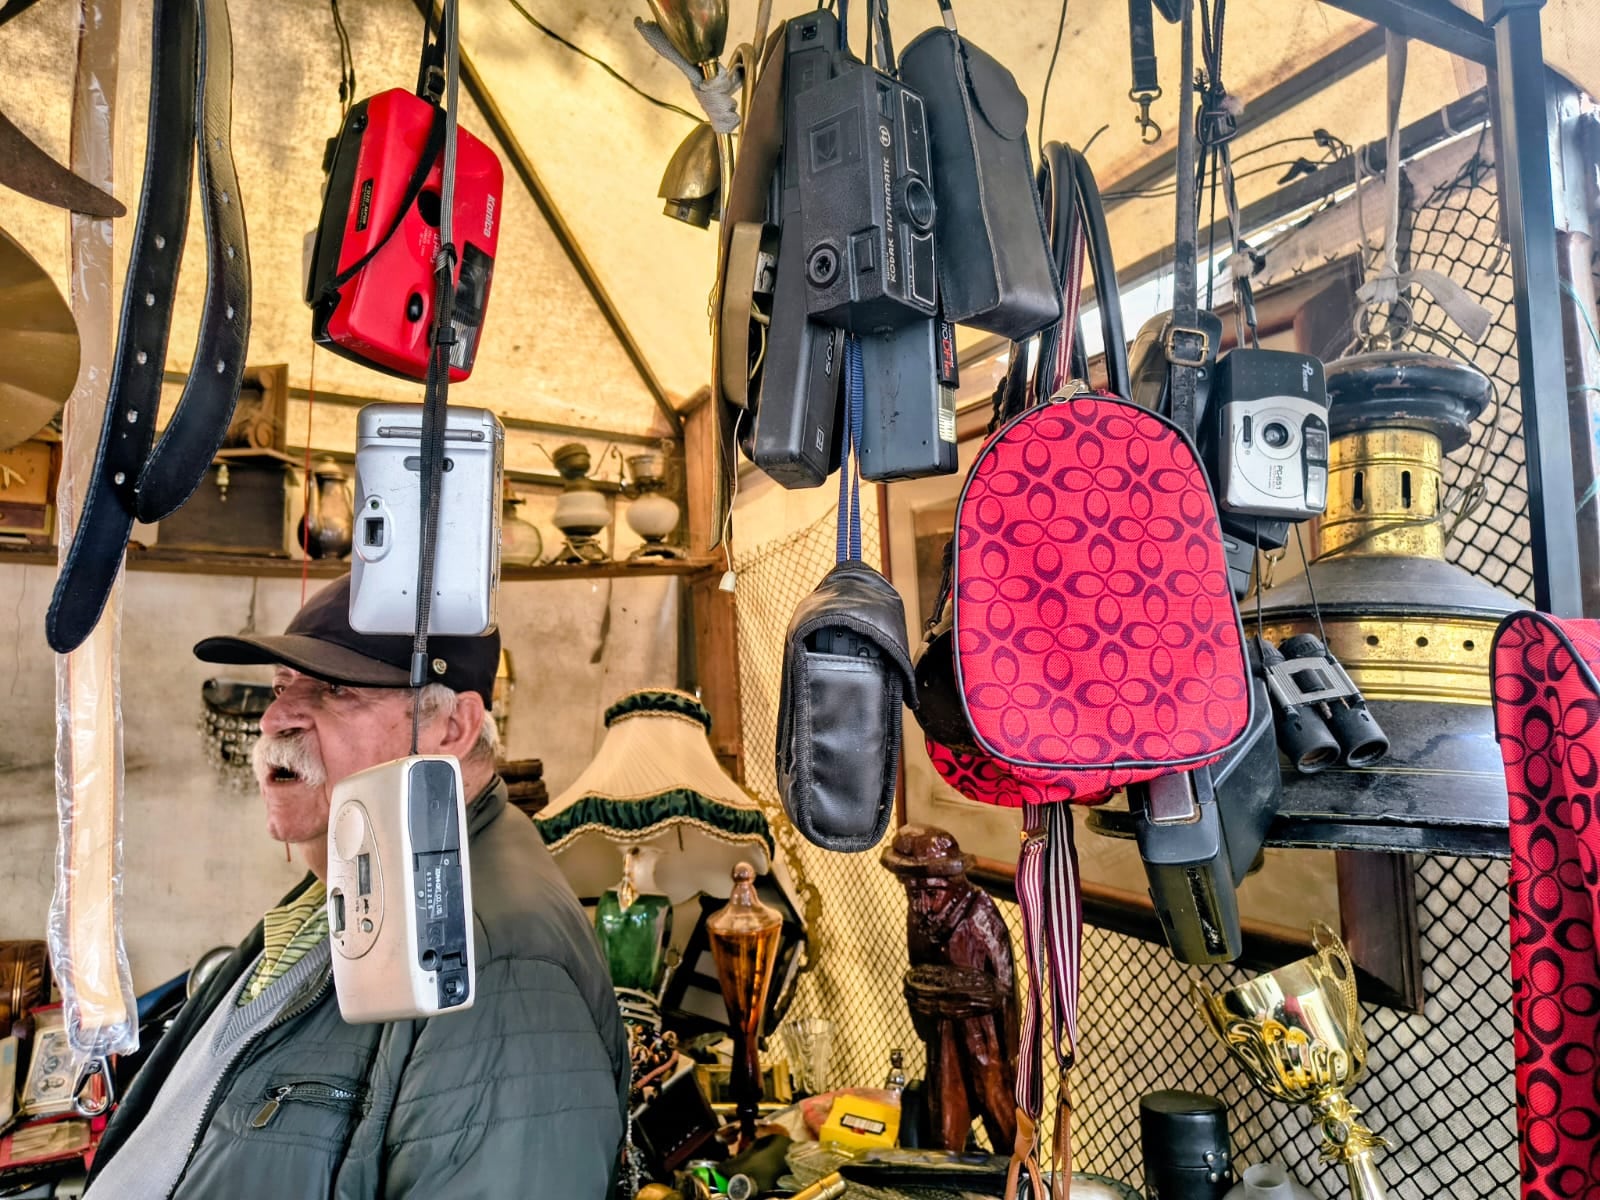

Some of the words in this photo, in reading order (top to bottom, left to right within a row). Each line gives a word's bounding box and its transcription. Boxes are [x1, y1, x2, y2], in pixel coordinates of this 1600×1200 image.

[483, 193, 496, 239] Konica
[883, 157, 893, 232] INSTAMATIC
[888, 238, 897, 282] KODAK
